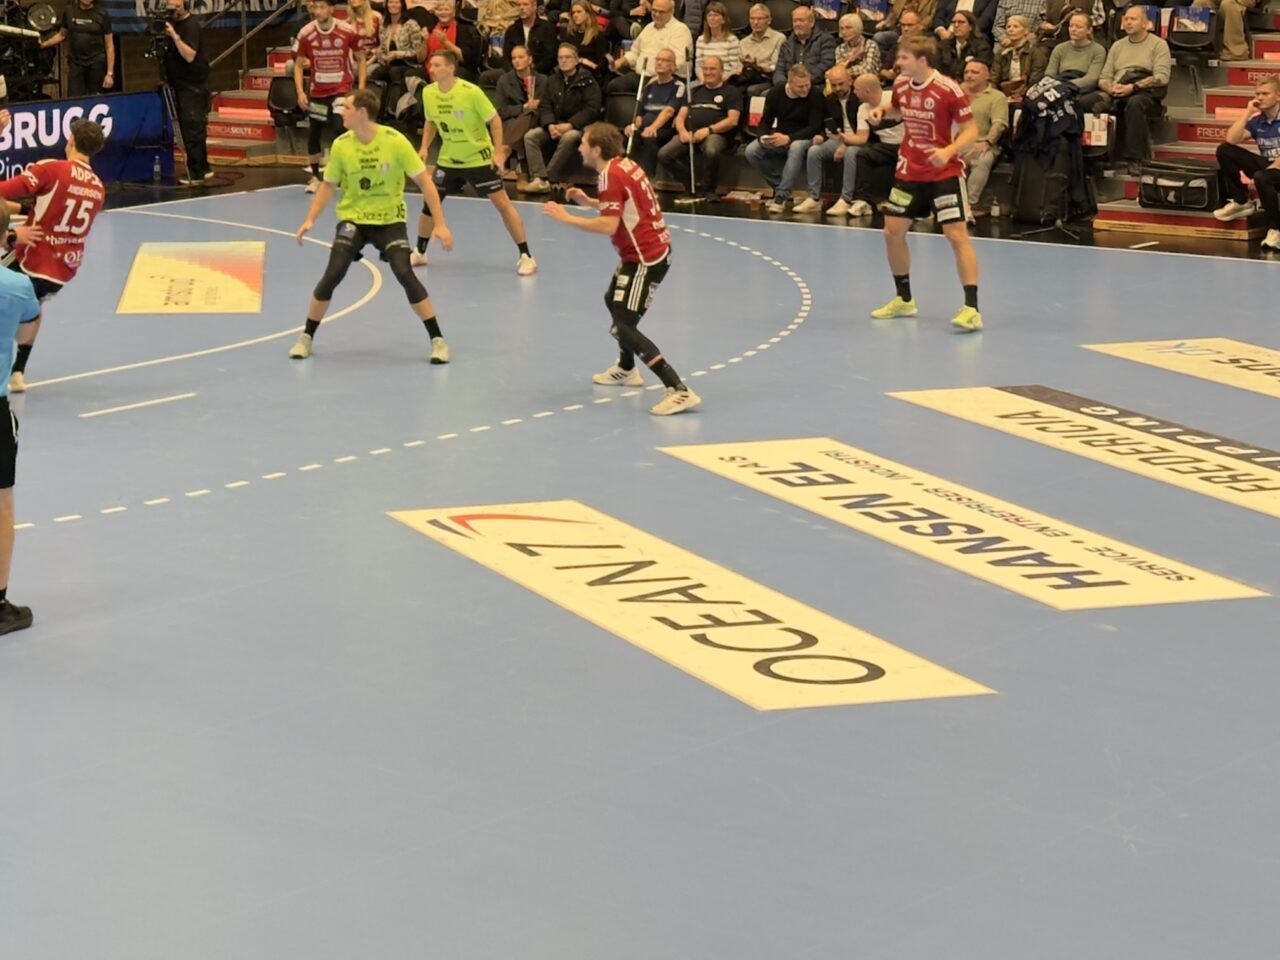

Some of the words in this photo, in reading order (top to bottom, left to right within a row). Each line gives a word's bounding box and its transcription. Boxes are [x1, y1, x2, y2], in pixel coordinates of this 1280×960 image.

[54, 199, 94, 236] 15
[993, 410, 1280, 493] FREDERICIA
[754, 461, 855, 488] EL
[820, 492, 1129, 590] HANSEN
[1083, 543, 1197, 582] SERVICE
